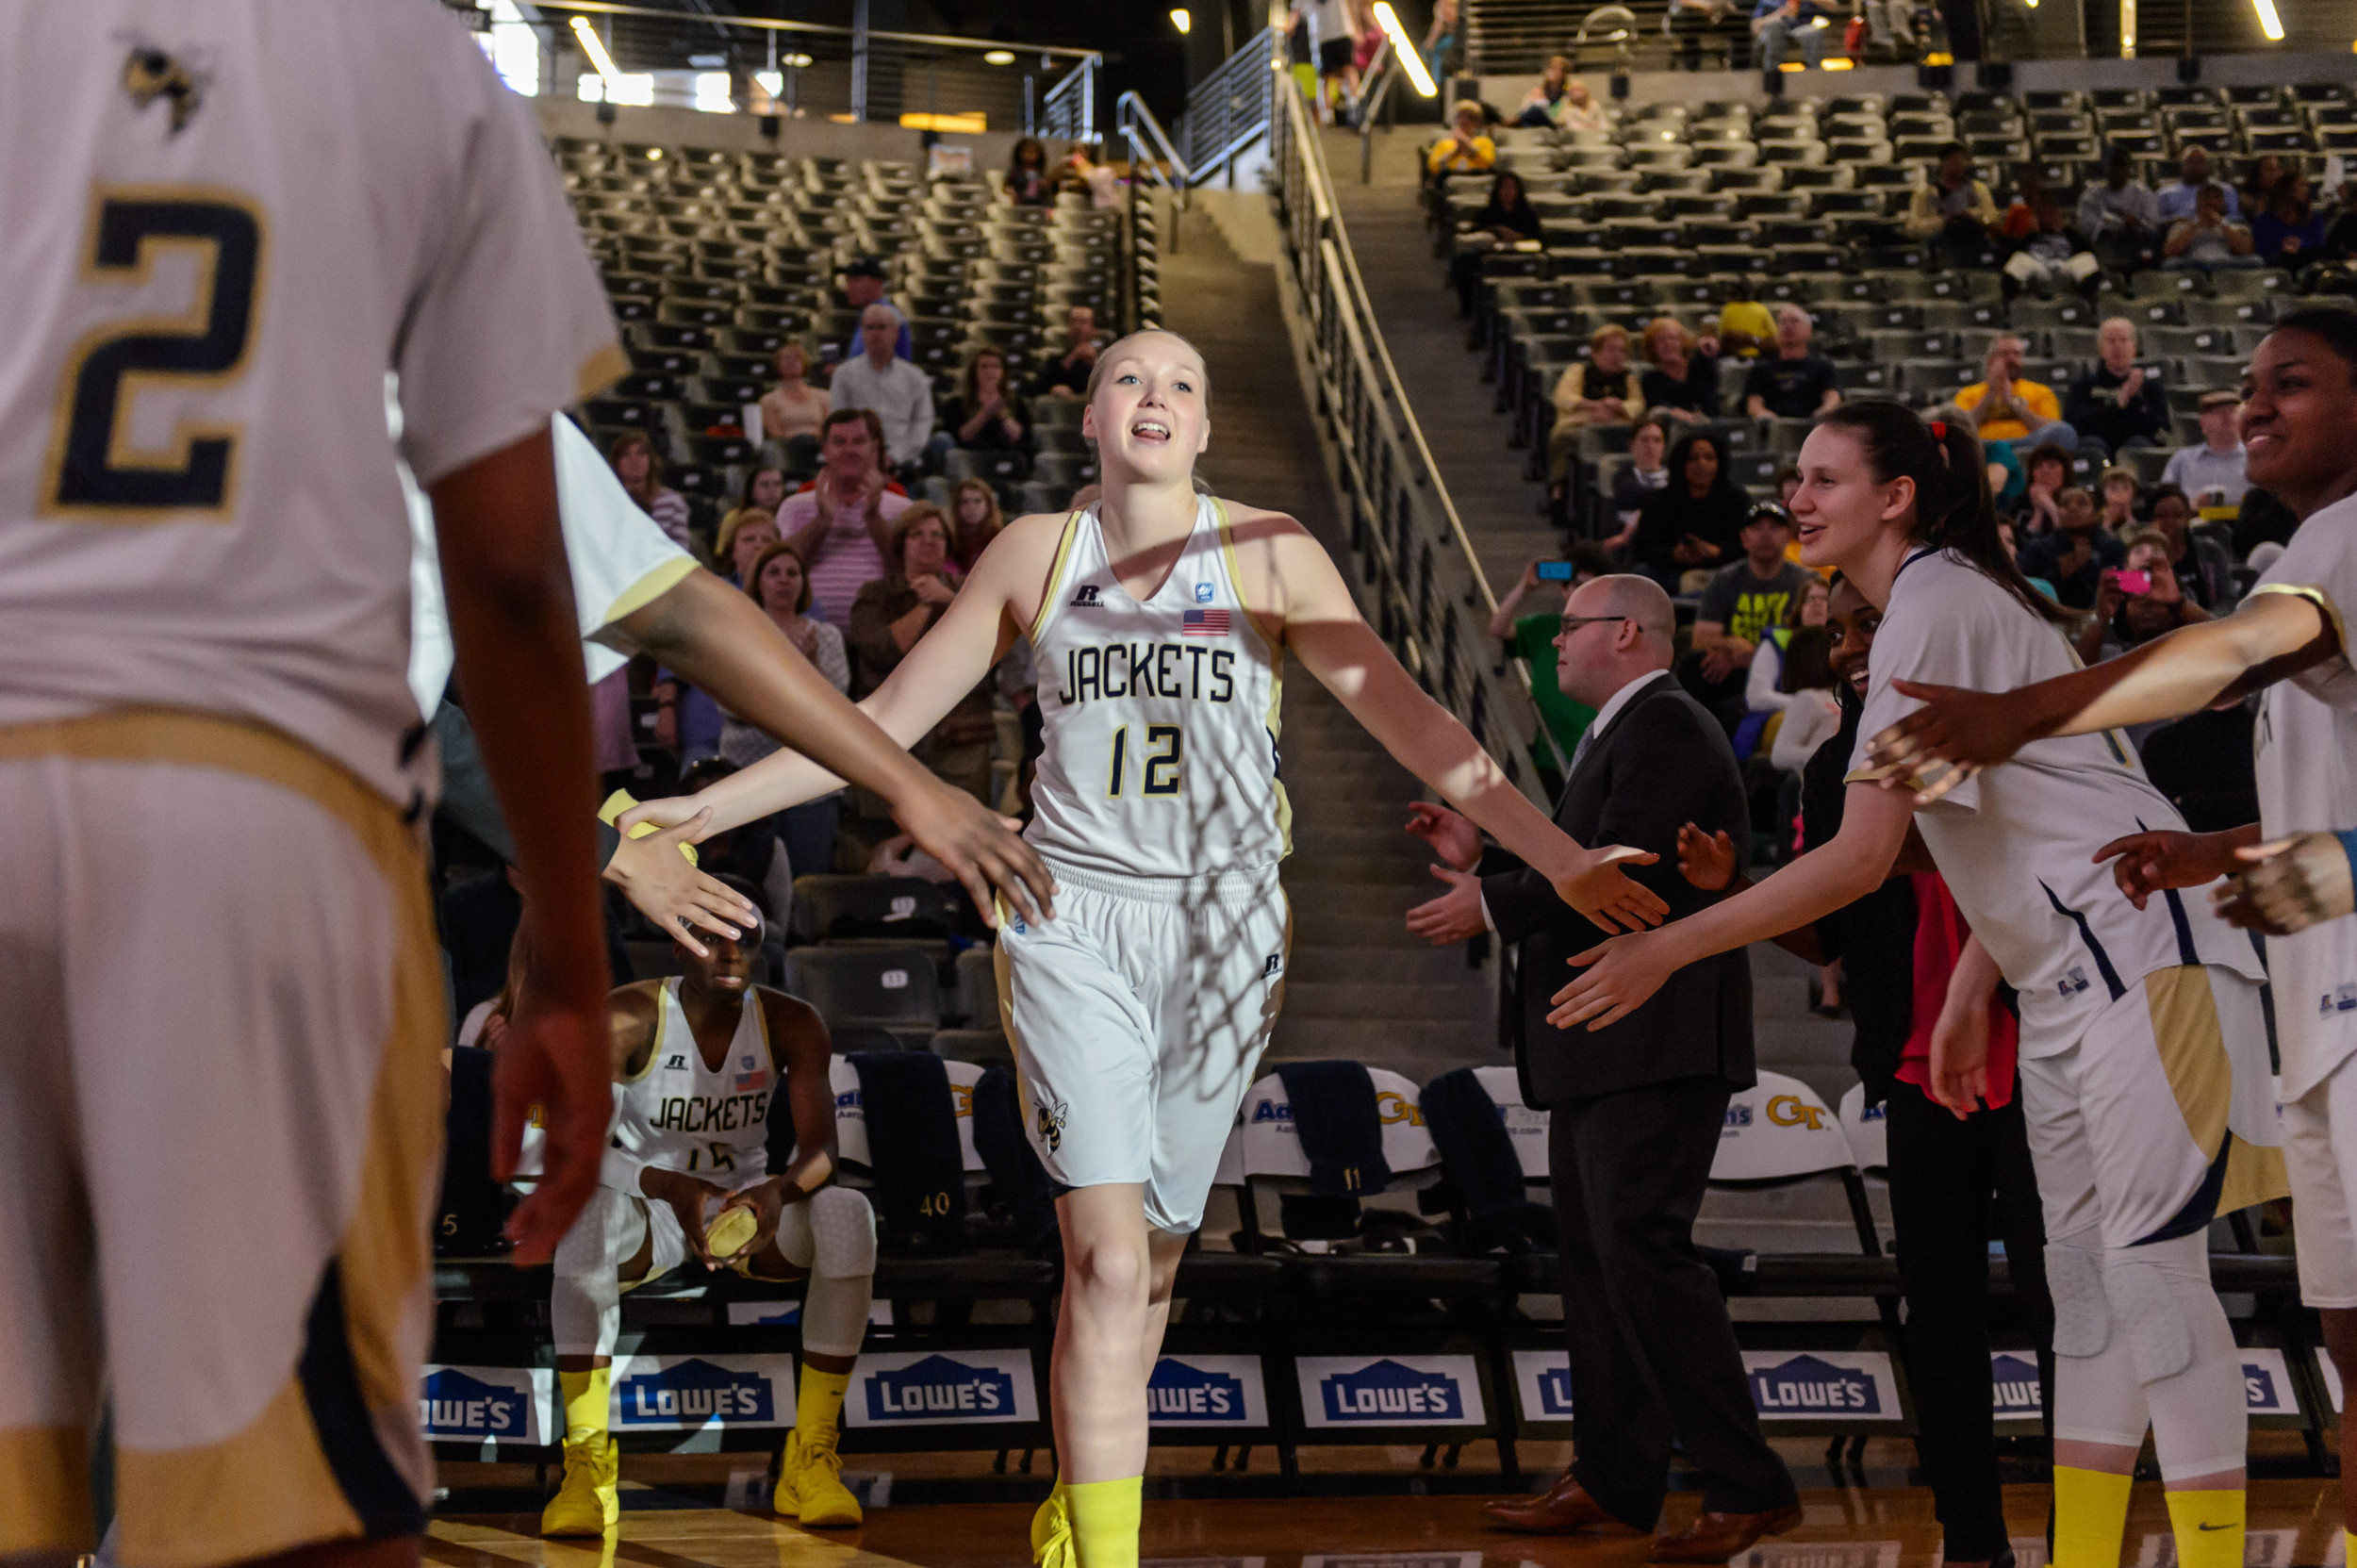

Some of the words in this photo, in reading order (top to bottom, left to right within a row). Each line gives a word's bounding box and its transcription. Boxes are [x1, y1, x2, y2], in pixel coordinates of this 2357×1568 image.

[36, 181, 272, 524] 2
[1076, 585, 1100, 601] R
[1058, 641, 1236, 706] JACKETS
[1107, 722, 1183, 800] 12
[650, 1092, 767, 1132] JACKETS
[1766, 1095, 1826, 1131] GT
[919, 1192, 950, 1217] 40
[443, 1213, 457, 1235] 5
[635, 1383, 758, 1416] LOWE'S
[881, 1378, 999, 1412] LOWE'S
[1335, 1383, 1449, 1413] LOWE'S
[1758, 1378, 1866, 1408] LOWE'S
